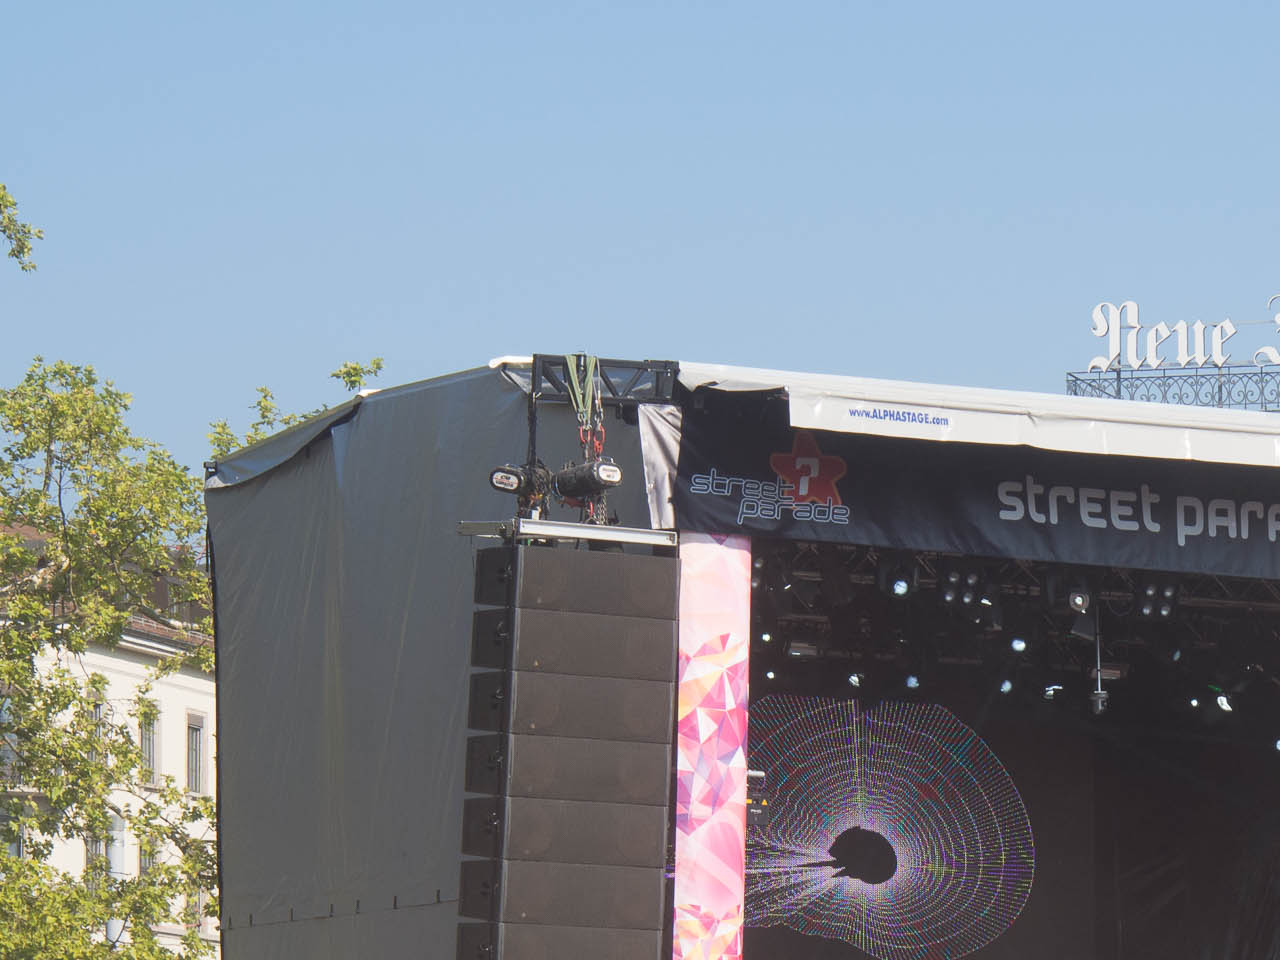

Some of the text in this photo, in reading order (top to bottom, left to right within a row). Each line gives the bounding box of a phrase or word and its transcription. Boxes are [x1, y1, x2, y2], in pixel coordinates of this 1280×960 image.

[1088, 300, 1238, 373] Neue
[848, 408, 950, 426] www.ALPHASTAGE.com
[690, 468, 794, 503] street
[737, 497, 850, 525] parade
